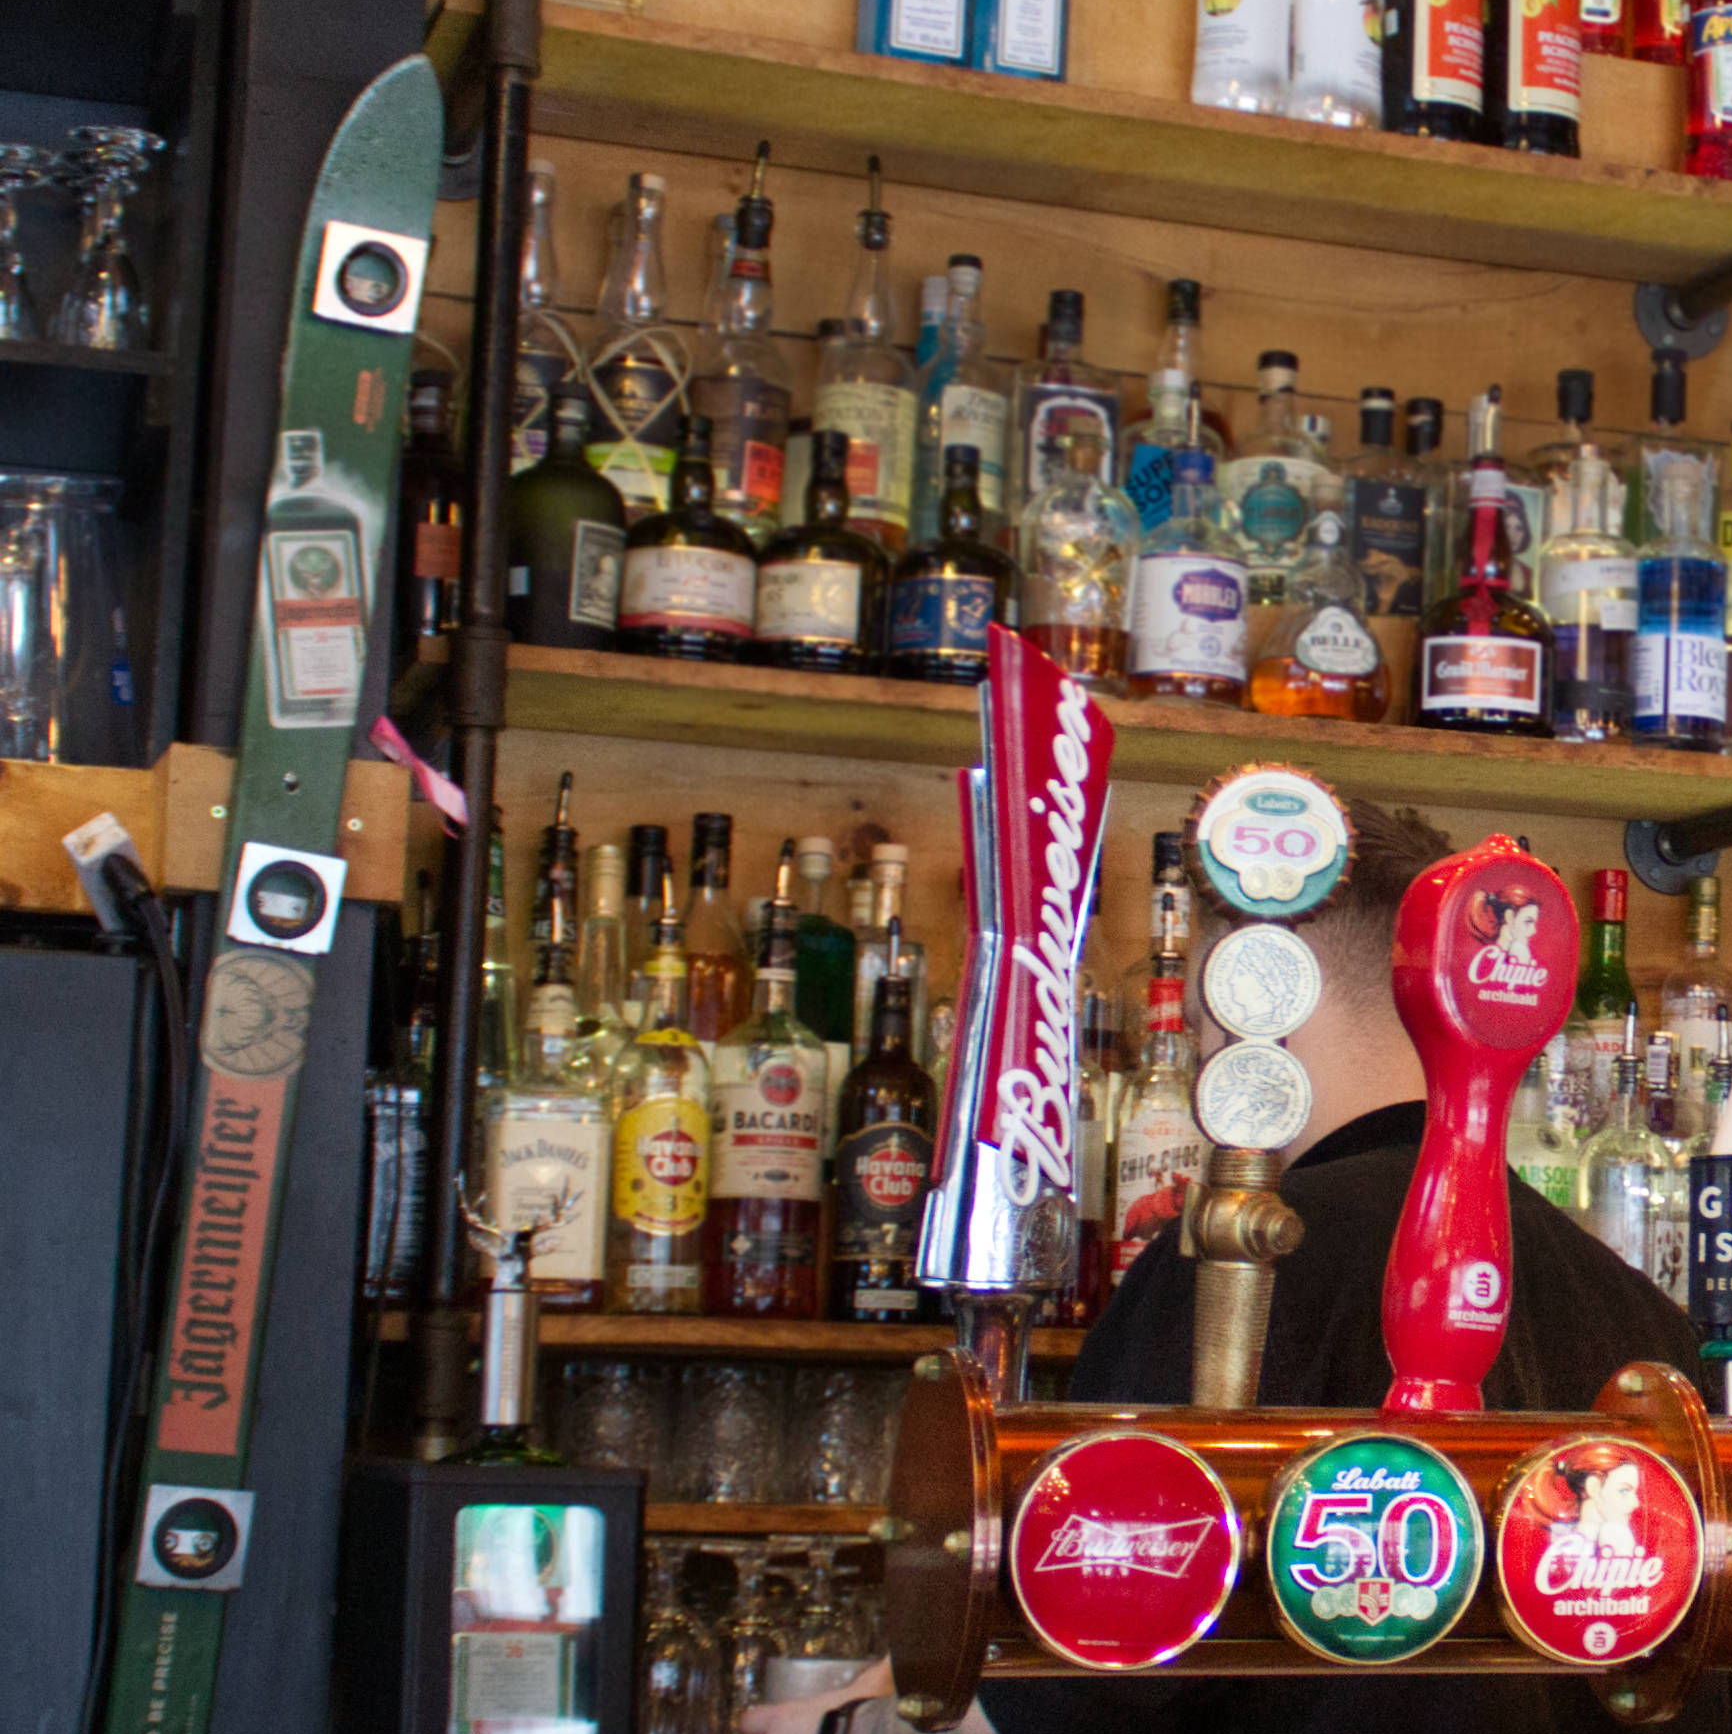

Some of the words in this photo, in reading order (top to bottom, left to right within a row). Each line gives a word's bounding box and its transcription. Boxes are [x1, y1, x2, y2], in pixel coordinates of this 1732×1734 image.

[1232, 825, 1317, 859] 50
[997, 678, 1092, 1207] Budweiser
[1467, 945, 1549, 990] Chipie
[1477, 988, 1539, 1007] archibald
[636, 1134, 704, 1158] Havana
[651, 1155, 694, 1177] Club
[855, 1154, 927, 1178] Havana
[868, 1176, 914, 1197] Club
[881, 1222, 899, 1246] 7
[1330, 1466, 1423, 1492] Labatt
[1050, 1527, 1200, 1559] Budweiser
[1289, 1490, 1459, 1593] 50
[1534, 1532, 1665, 1597] Chipie
[1553, 1594, 1651, 1618] archibald
[152, 1611, 178, 1692] PRECISE
[147, 1697, 167, 1724] BE
